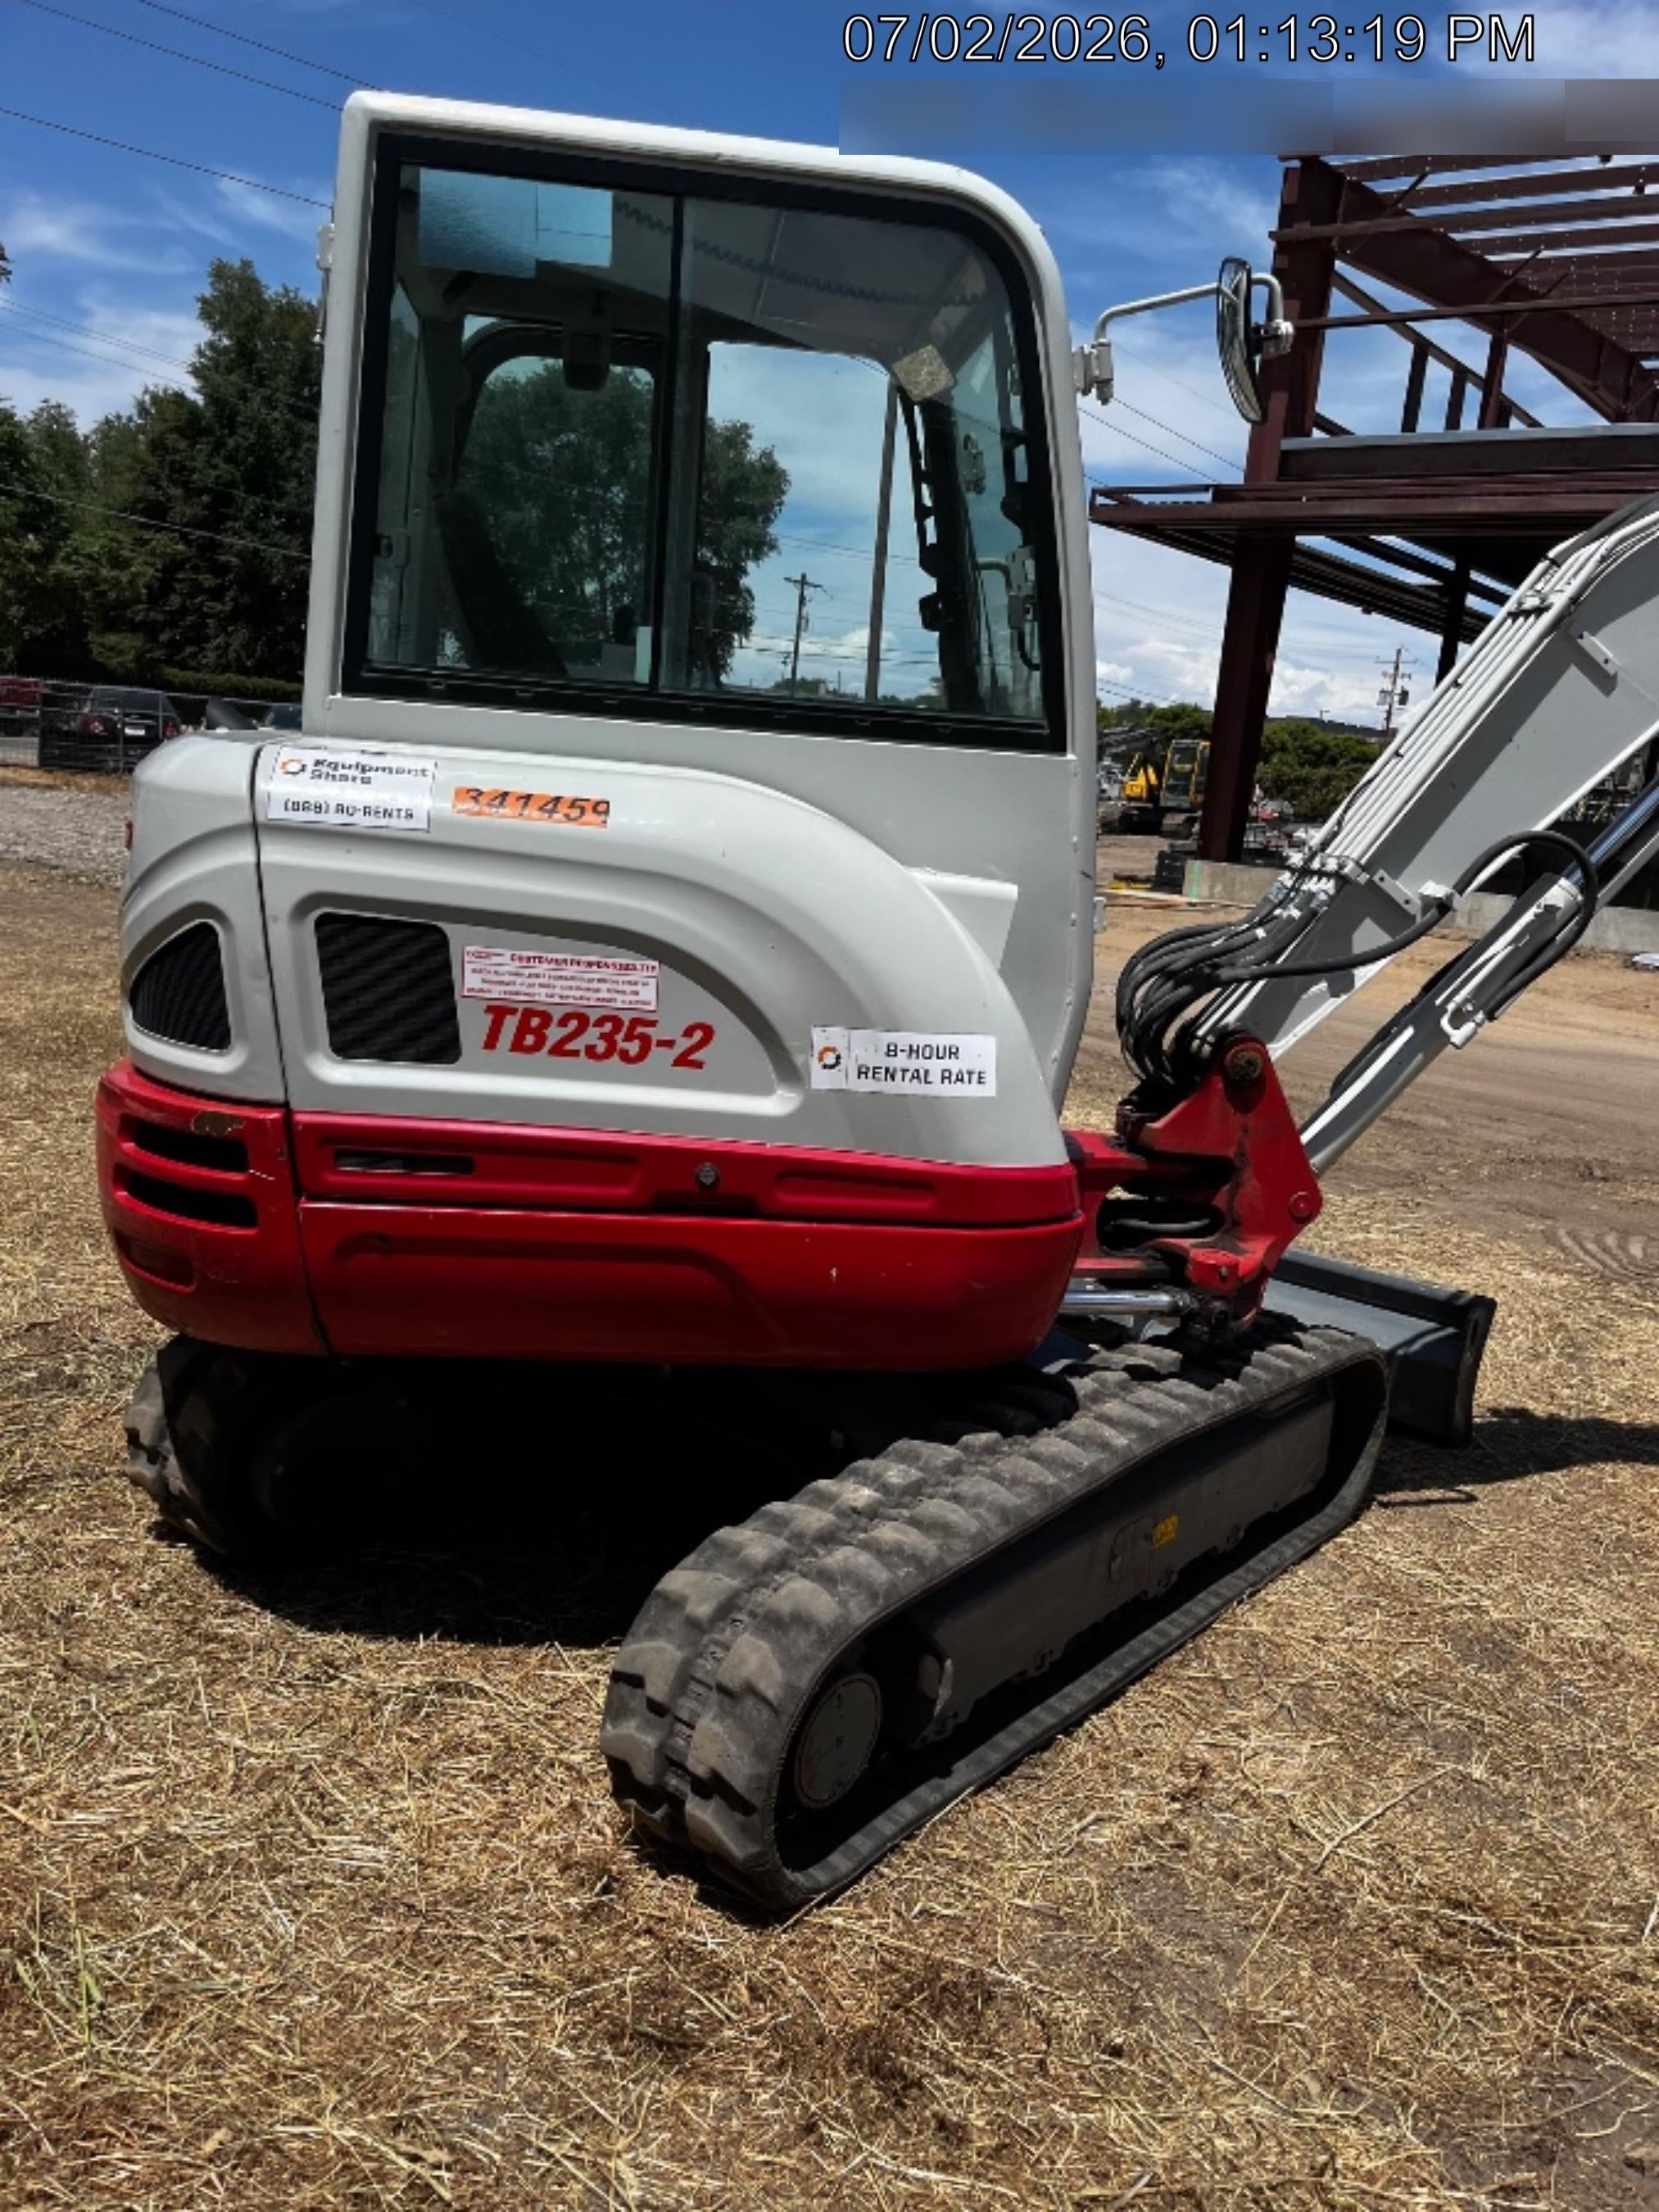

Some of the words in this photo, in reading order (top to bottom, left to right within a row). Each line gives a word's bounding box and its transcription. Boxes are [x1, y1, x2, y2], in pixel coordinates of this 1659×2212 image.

[466, 788, 610, 824] 341459
[482, 1005, 715, 1069] TB235-2
[885, 1043, 959, 1060] 8-HOUR
[857, 1065, 933, 1085] RENTAL
[941, 1068, 987, 1085] RATE
